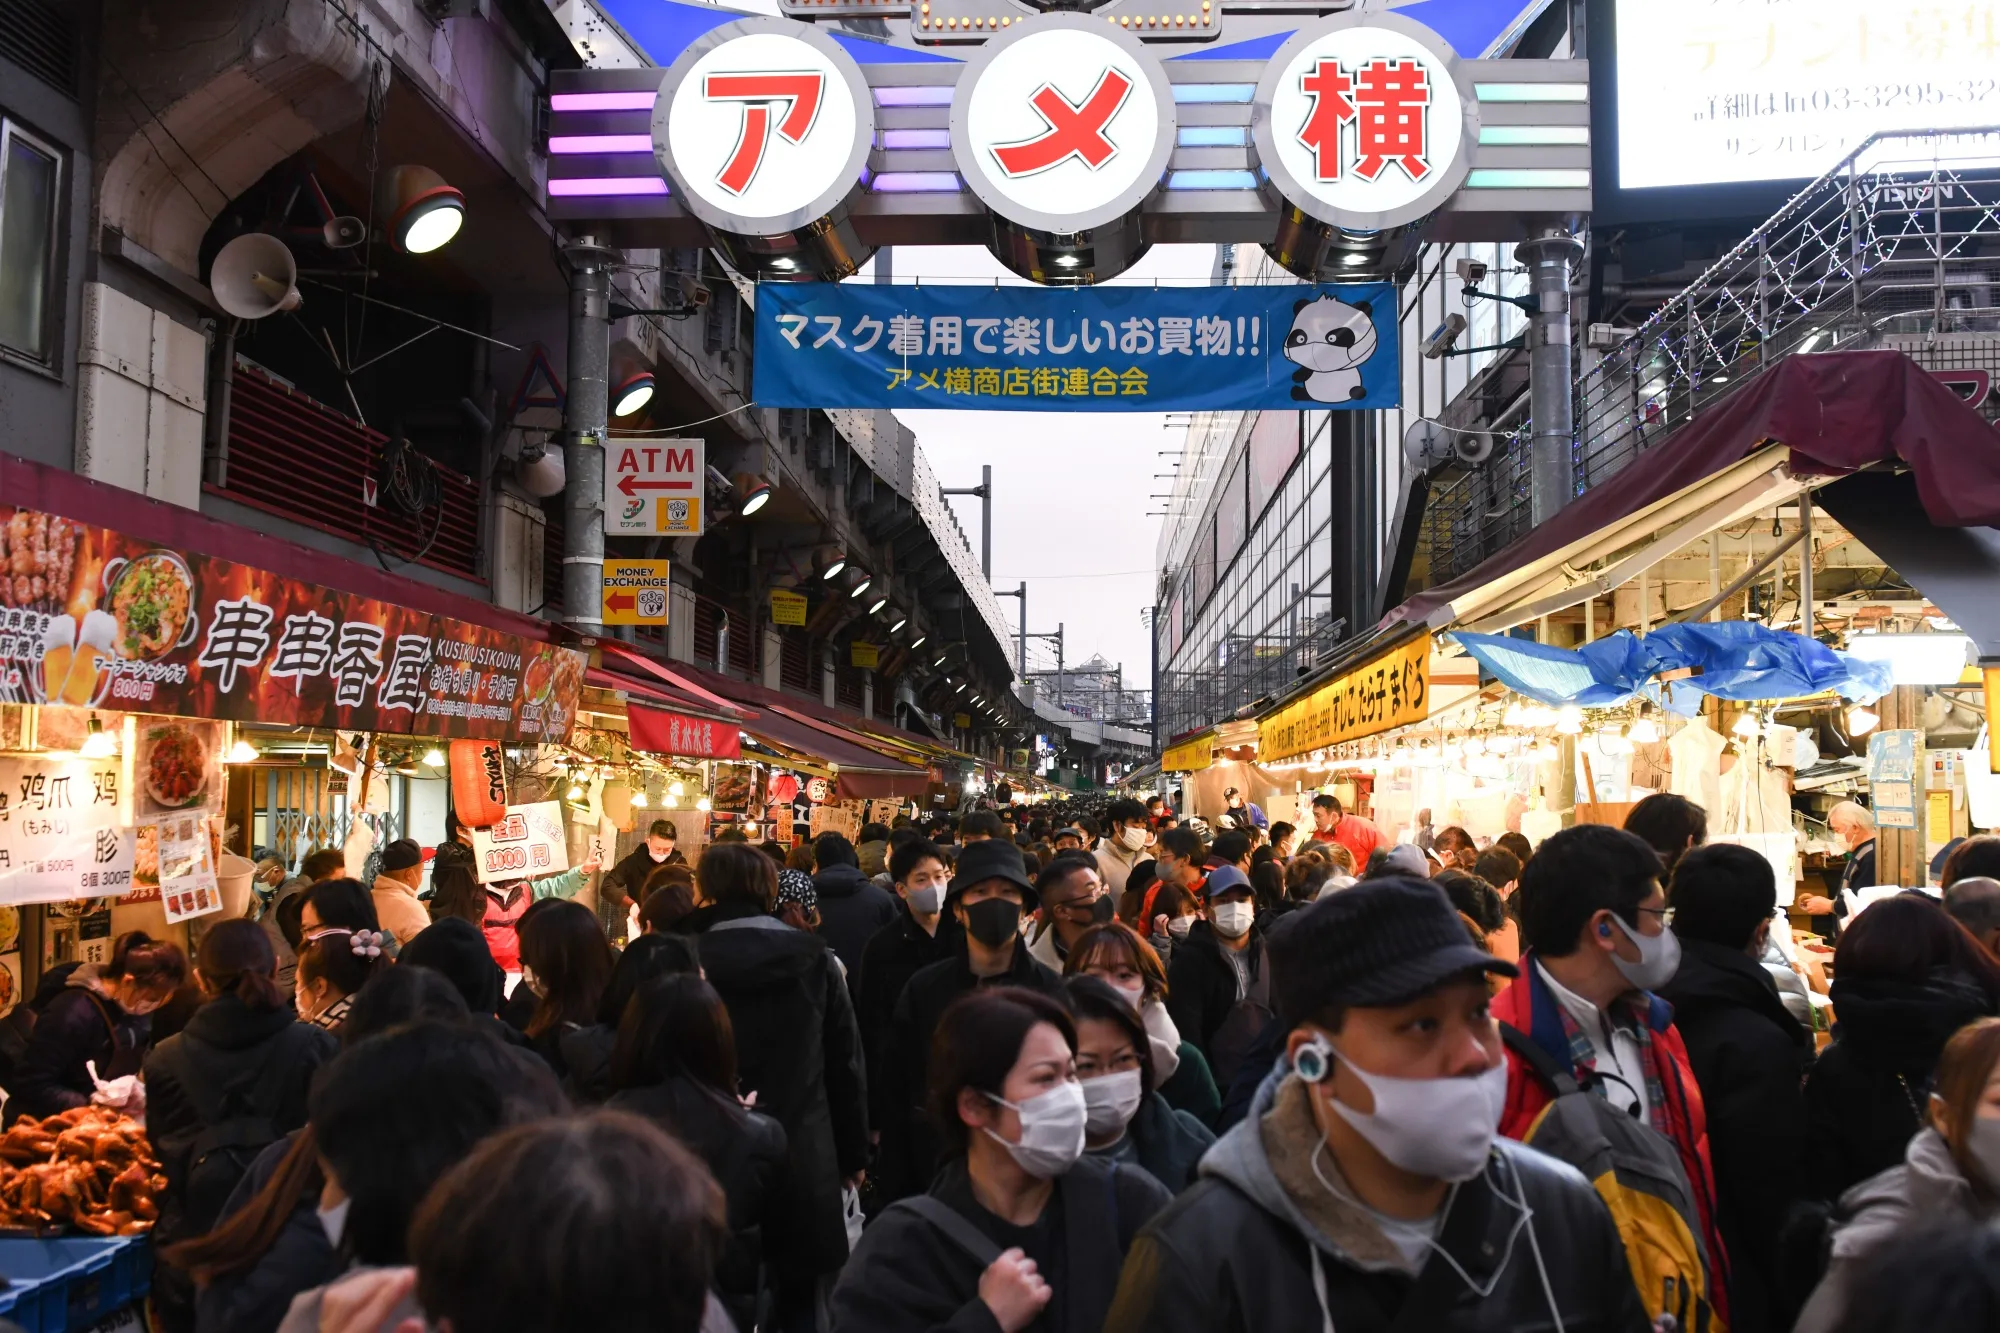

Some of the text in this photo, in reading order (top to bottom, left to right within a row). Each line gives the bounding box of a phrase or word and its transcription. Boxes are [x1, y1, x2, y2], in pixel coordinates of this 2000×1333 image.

[774, 314, 1260, 356] マスク着用で楽しいお買物!!
[885, 367, 1148, 397] アメ横商店街連合会
[617, 449, 694, 472] ATM
[604, 578, 667, 587] EXCHANGE
[616, 568, 655, 576] MONEY
[435, 638, 521, 671] KUSIKUSIKOUYA
[113, 678, 154, 700] 800円
[1333, 653, 1425, 734] すじこ たら子 まぐろ
[491, 816, 527, 842] 全品
[486, 844, 549, 872] 1000 円
[81, 870, 130, 887] 8個 300円
